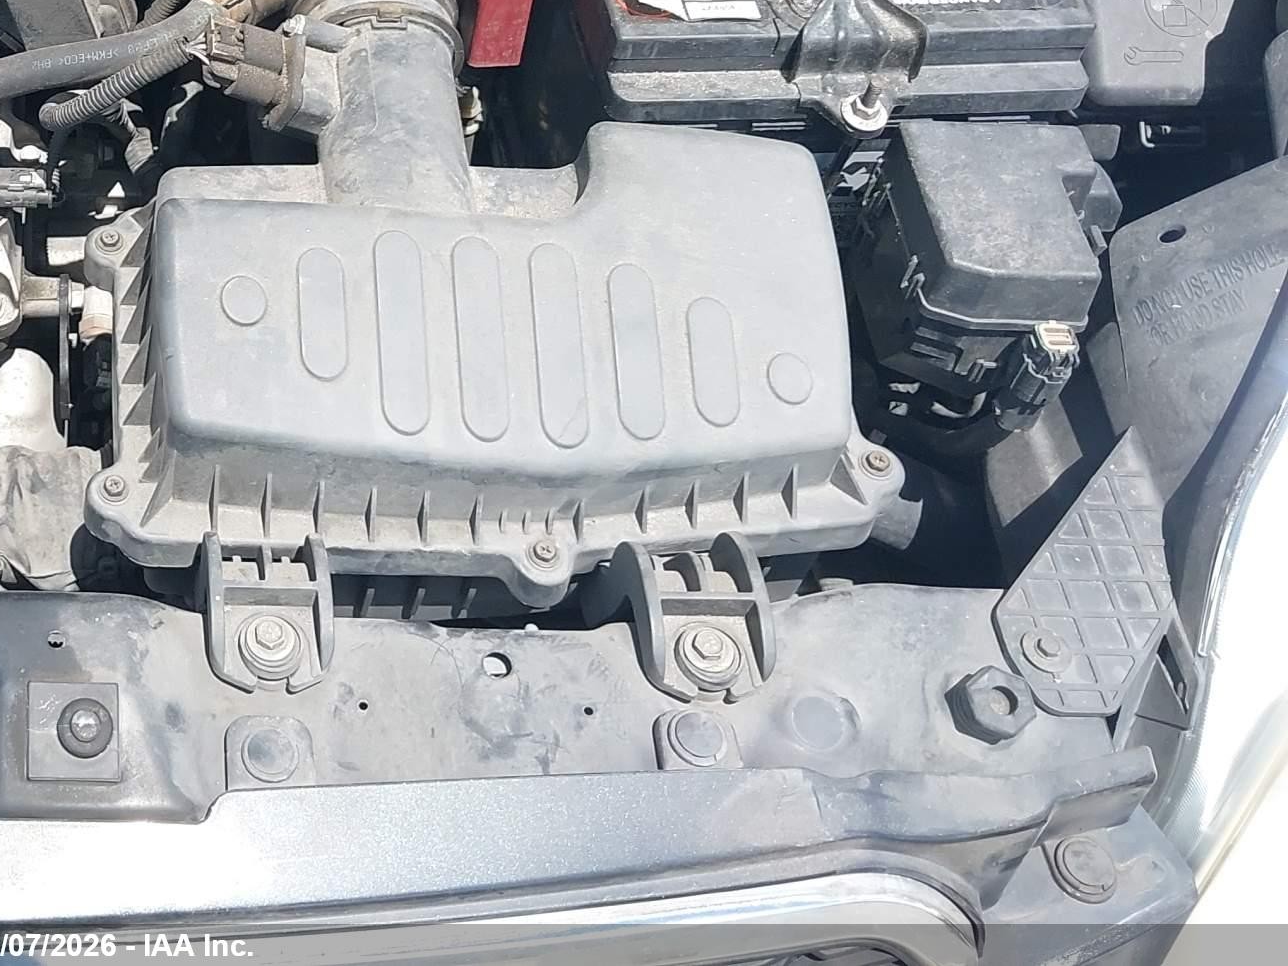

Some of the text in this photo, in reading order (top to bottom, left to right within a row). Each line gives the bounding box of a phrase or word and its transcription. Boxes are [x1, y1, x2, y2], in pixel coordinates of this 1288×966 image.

[1132, 298, 1153, 326] DO
[1179, 272, 1213, 300] USE
[1209, 257, 1244, 290] THIS
[1239, 244, 1286, 274] HOLE
[1212, 289, 1248, 319] STAY
